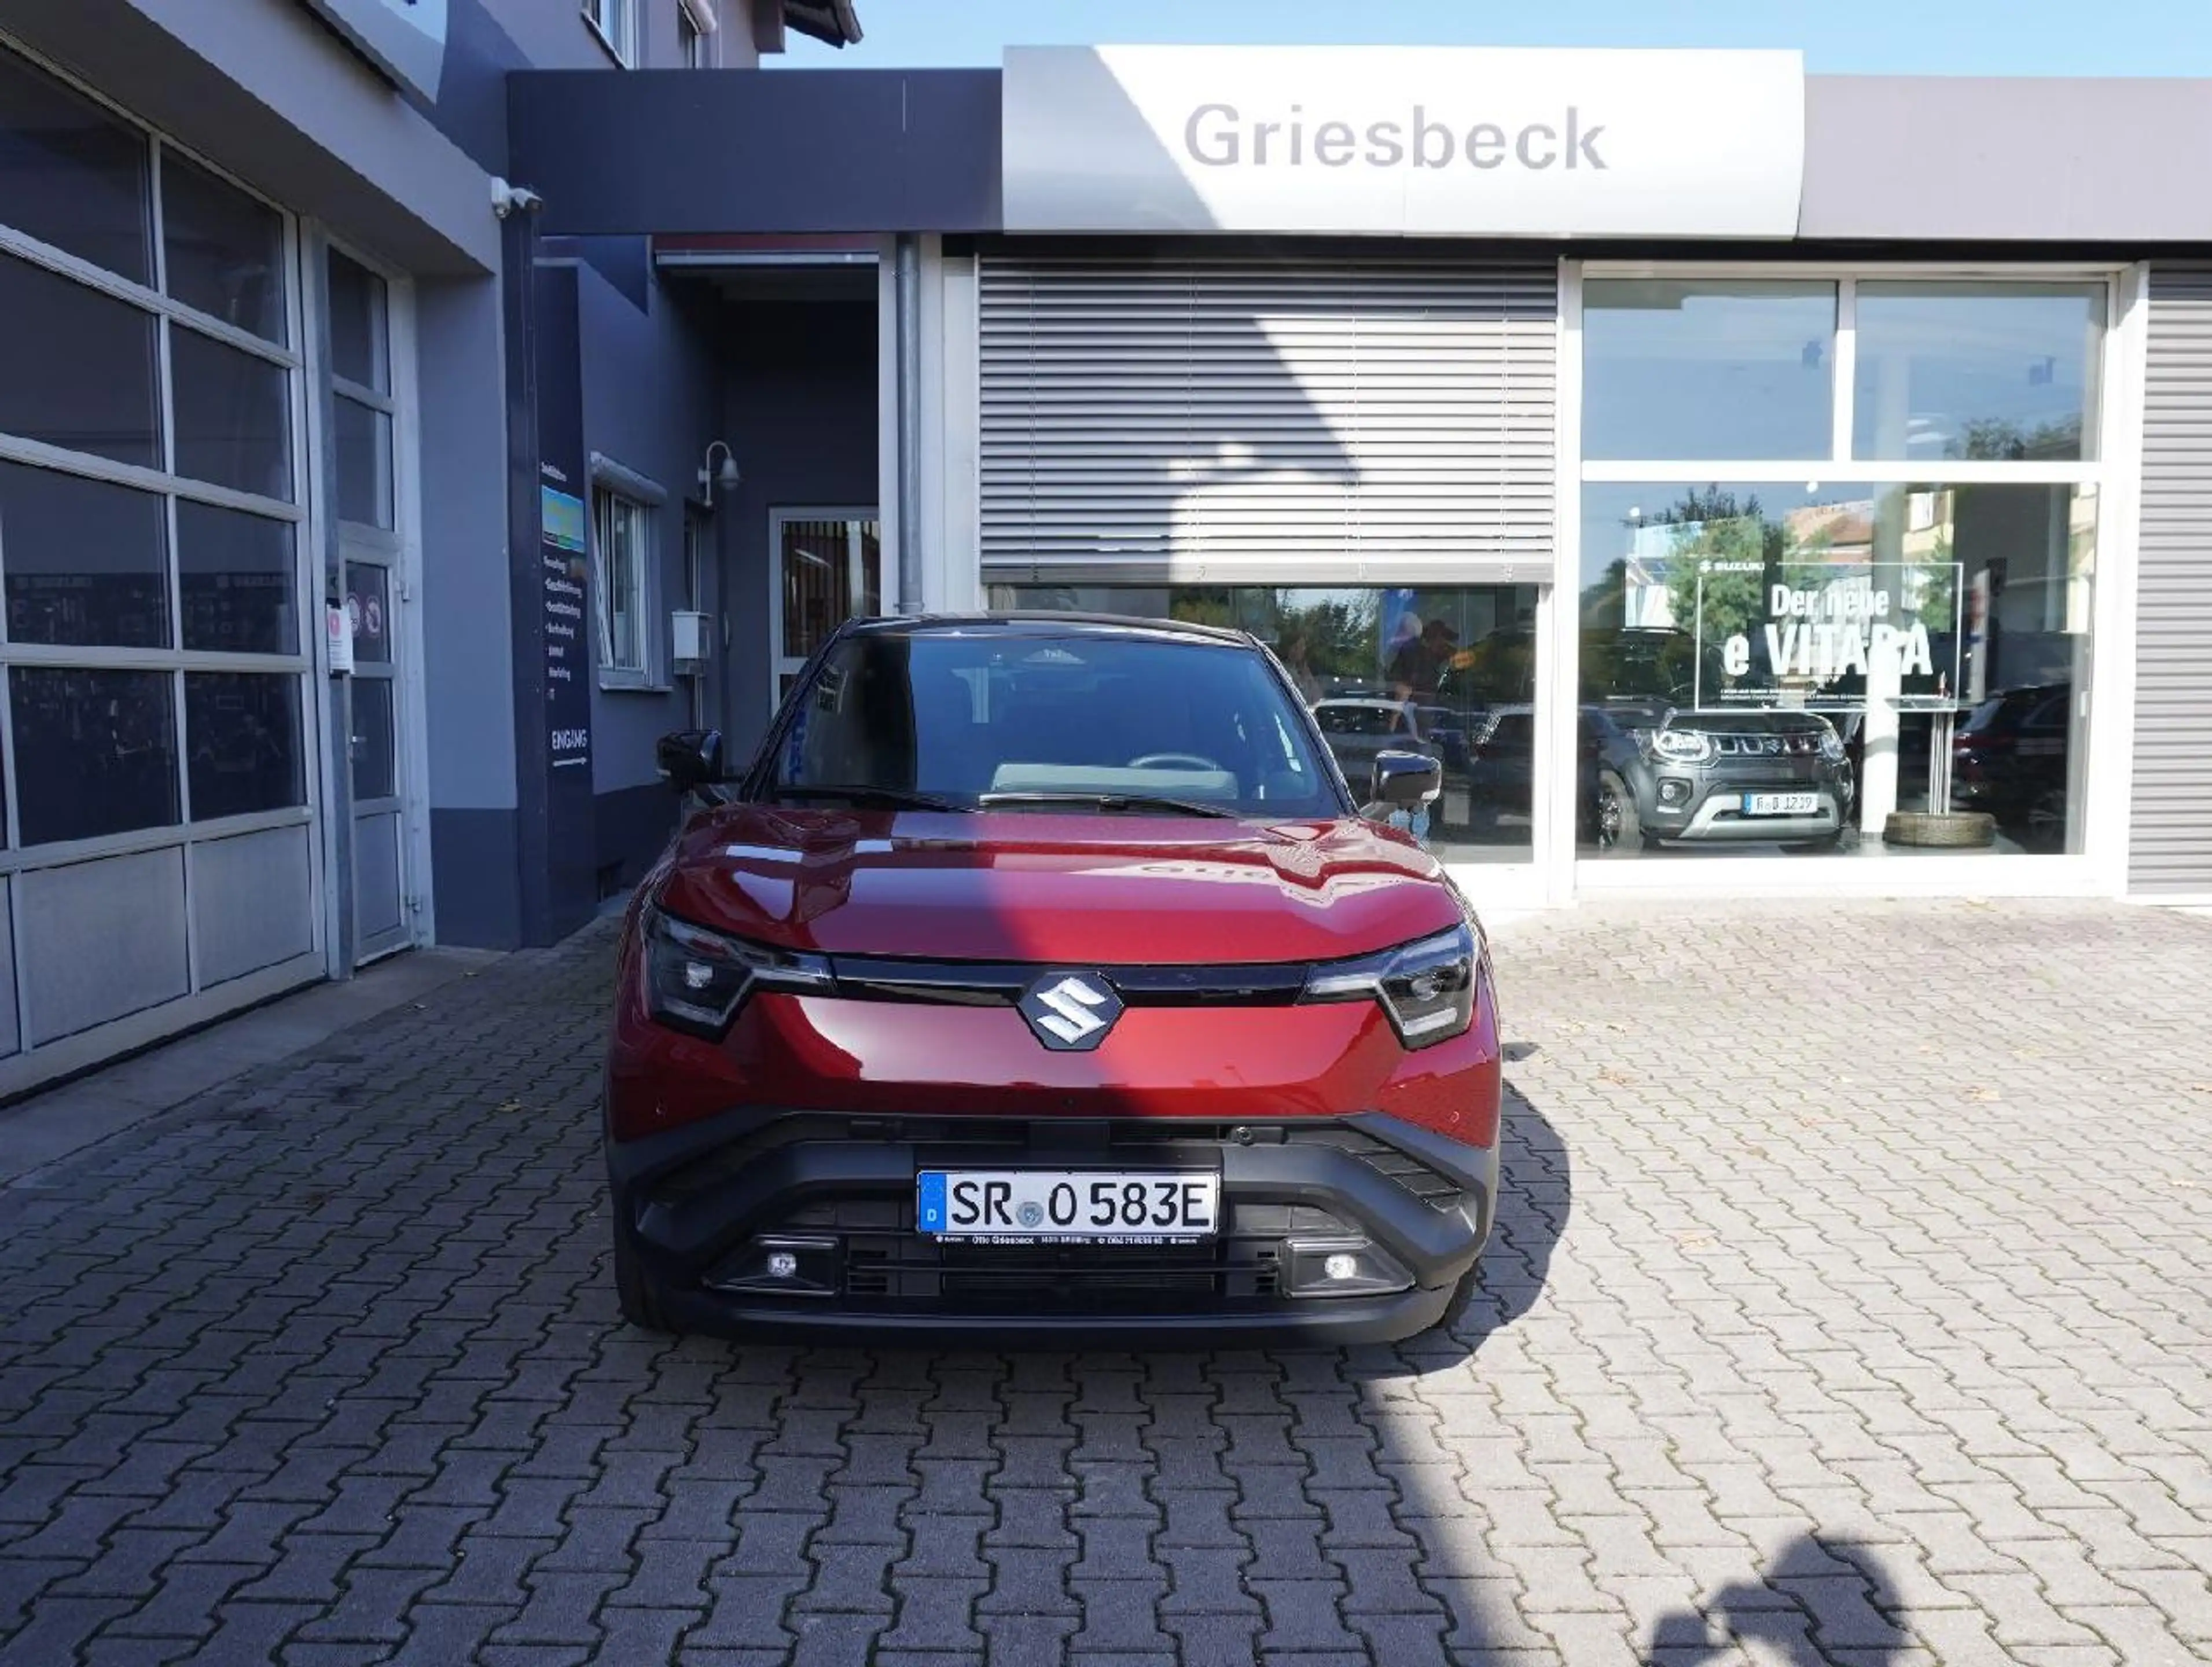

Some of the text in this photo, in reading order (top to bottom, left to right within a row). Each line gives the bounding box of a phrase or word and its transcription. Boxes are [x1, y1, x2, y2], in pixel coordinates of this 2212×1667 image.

[1184, 103, 1610, 170] Griesbeck
[1771, 584, 1889, 617] Der neue
[1724, 623, 1934, 676] e VITARA
[927, 1209, 938, 1222] D
[951, 1181, 1013, 1225] SR
[1090, 1182, 1210, 1227] 583E
